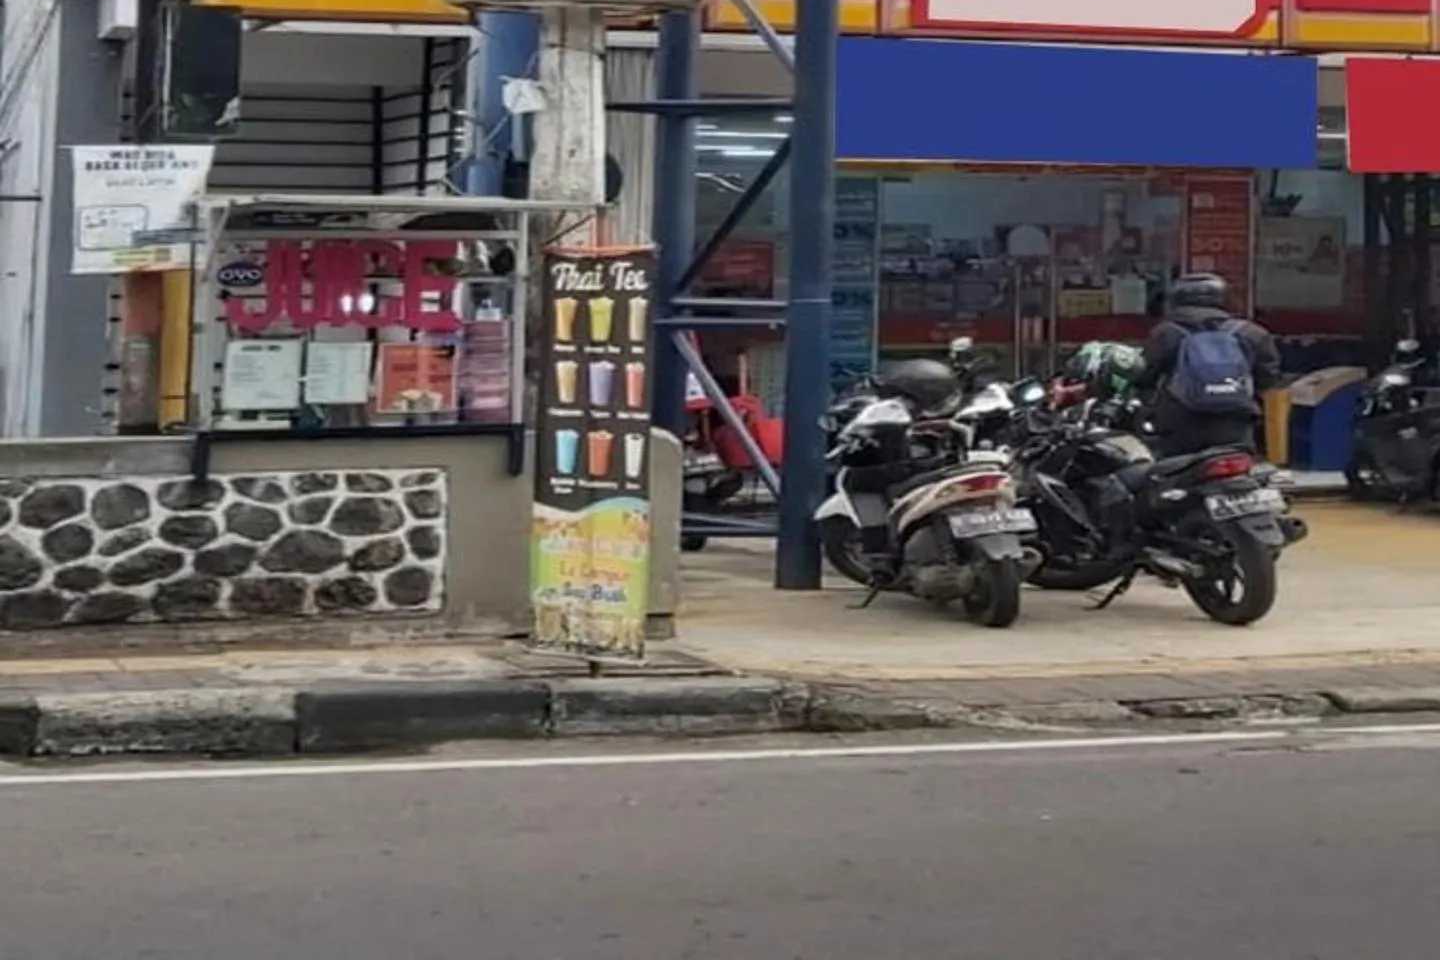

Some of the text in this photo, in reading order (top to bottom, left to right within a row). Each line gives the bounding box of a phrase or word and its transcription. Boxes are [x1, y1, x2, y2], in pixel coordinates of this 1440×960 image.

[219, 266, 262, 281] OVO
[551, 262, 650, 291] Thai Tea
